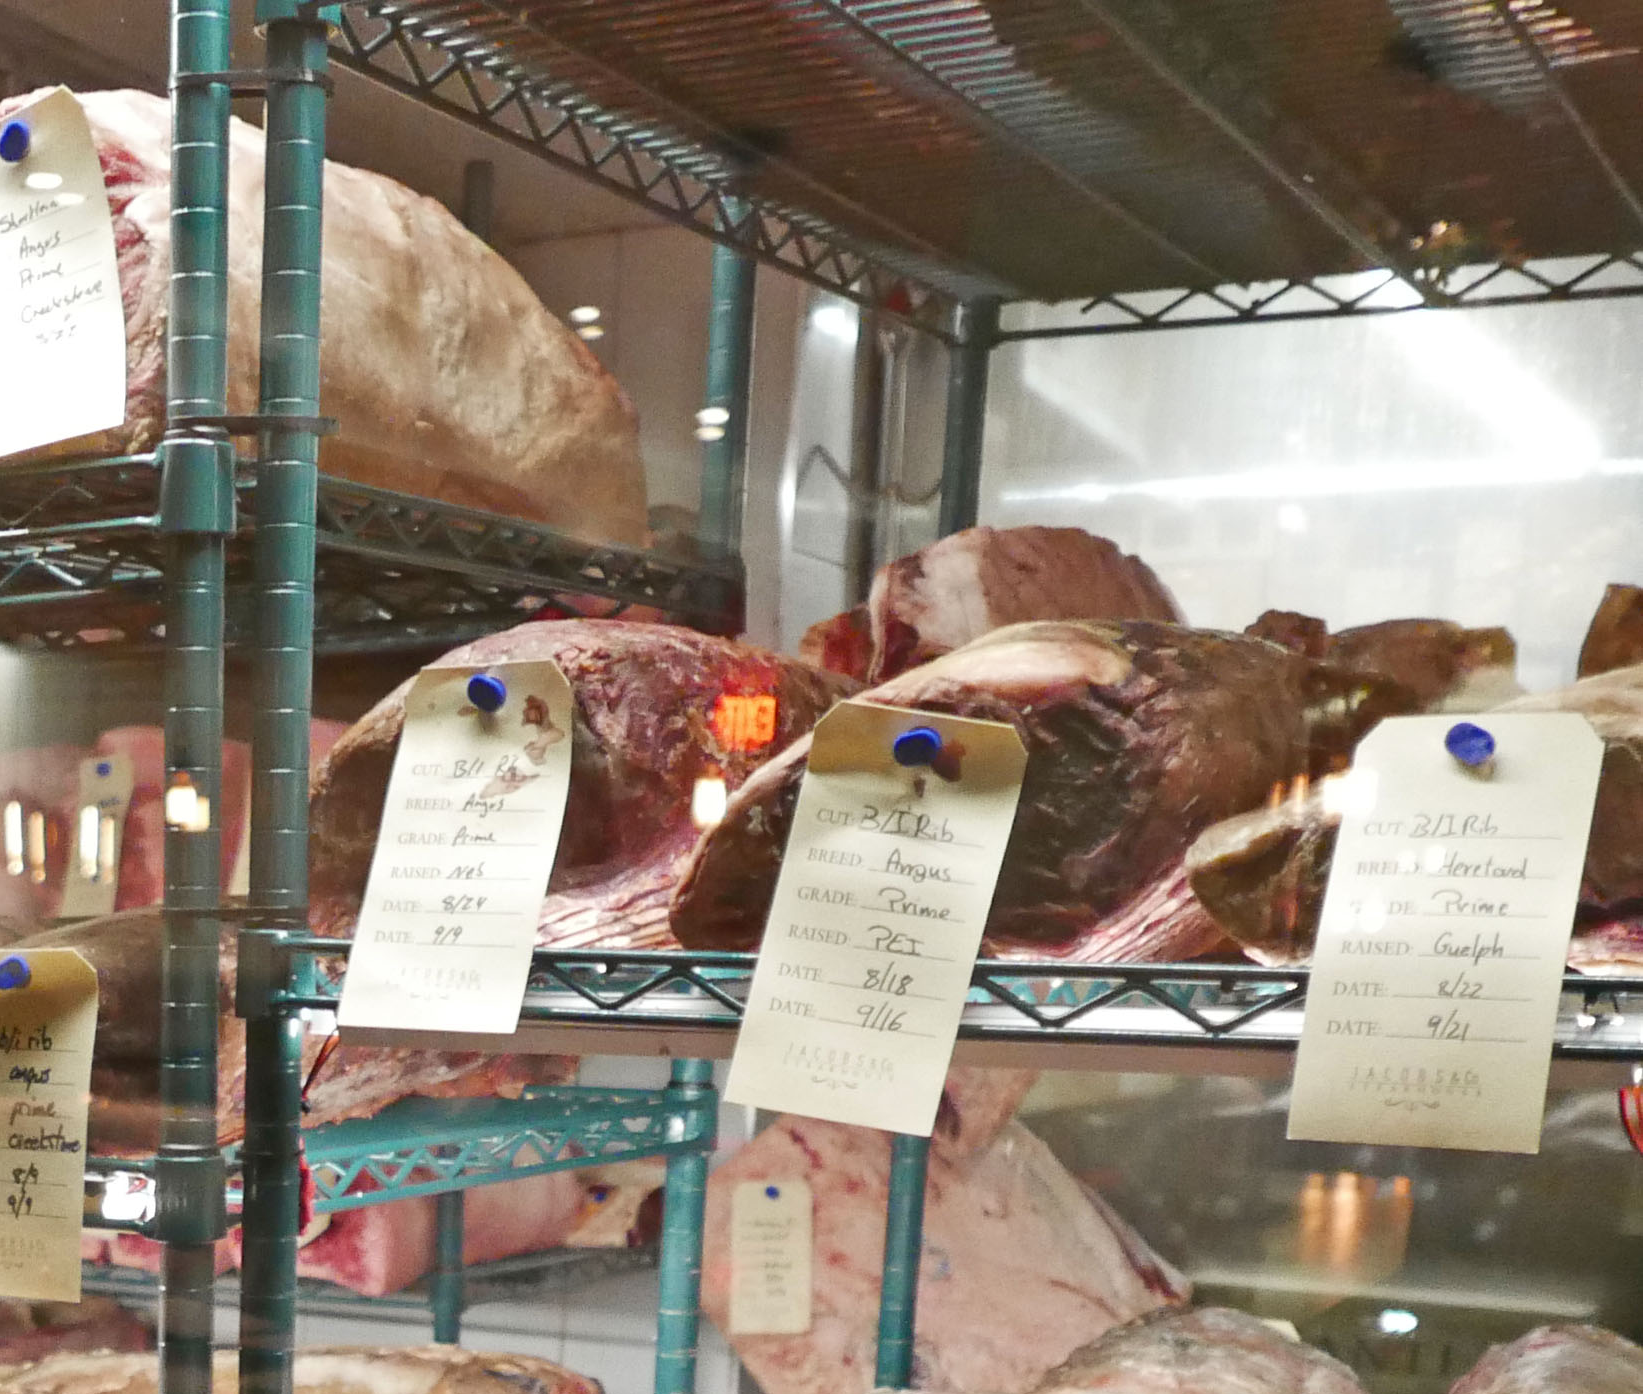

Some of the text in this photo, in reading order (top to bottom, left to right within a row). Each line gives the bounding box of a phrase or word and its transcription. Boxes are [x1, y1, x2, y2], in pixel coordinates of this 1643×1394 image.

[406, 793, 505, 819] BREED: Angus
[817, 808, 856, 825] CUT:
[452, 831, 496, 848] Prime
[1364, 821, 1406, 836] CUT:
[807, 847, 952, 883] BREED: Angus
[878, 887, 950, 921] Prime
[1431, 889, 1508, 917] Prime
[788, 924, 923, 957] RAISED: PEI
[1341, 932, 1504, 965] RAISED: Guelph
[863, 961, 914, 996] 8/18
[1333, 972, 1484, 999] DATE: 8/22
[856, 1000, 905, 1032] 9/16
[1326, 1010, 1469, 1041] DATE: 9/21
